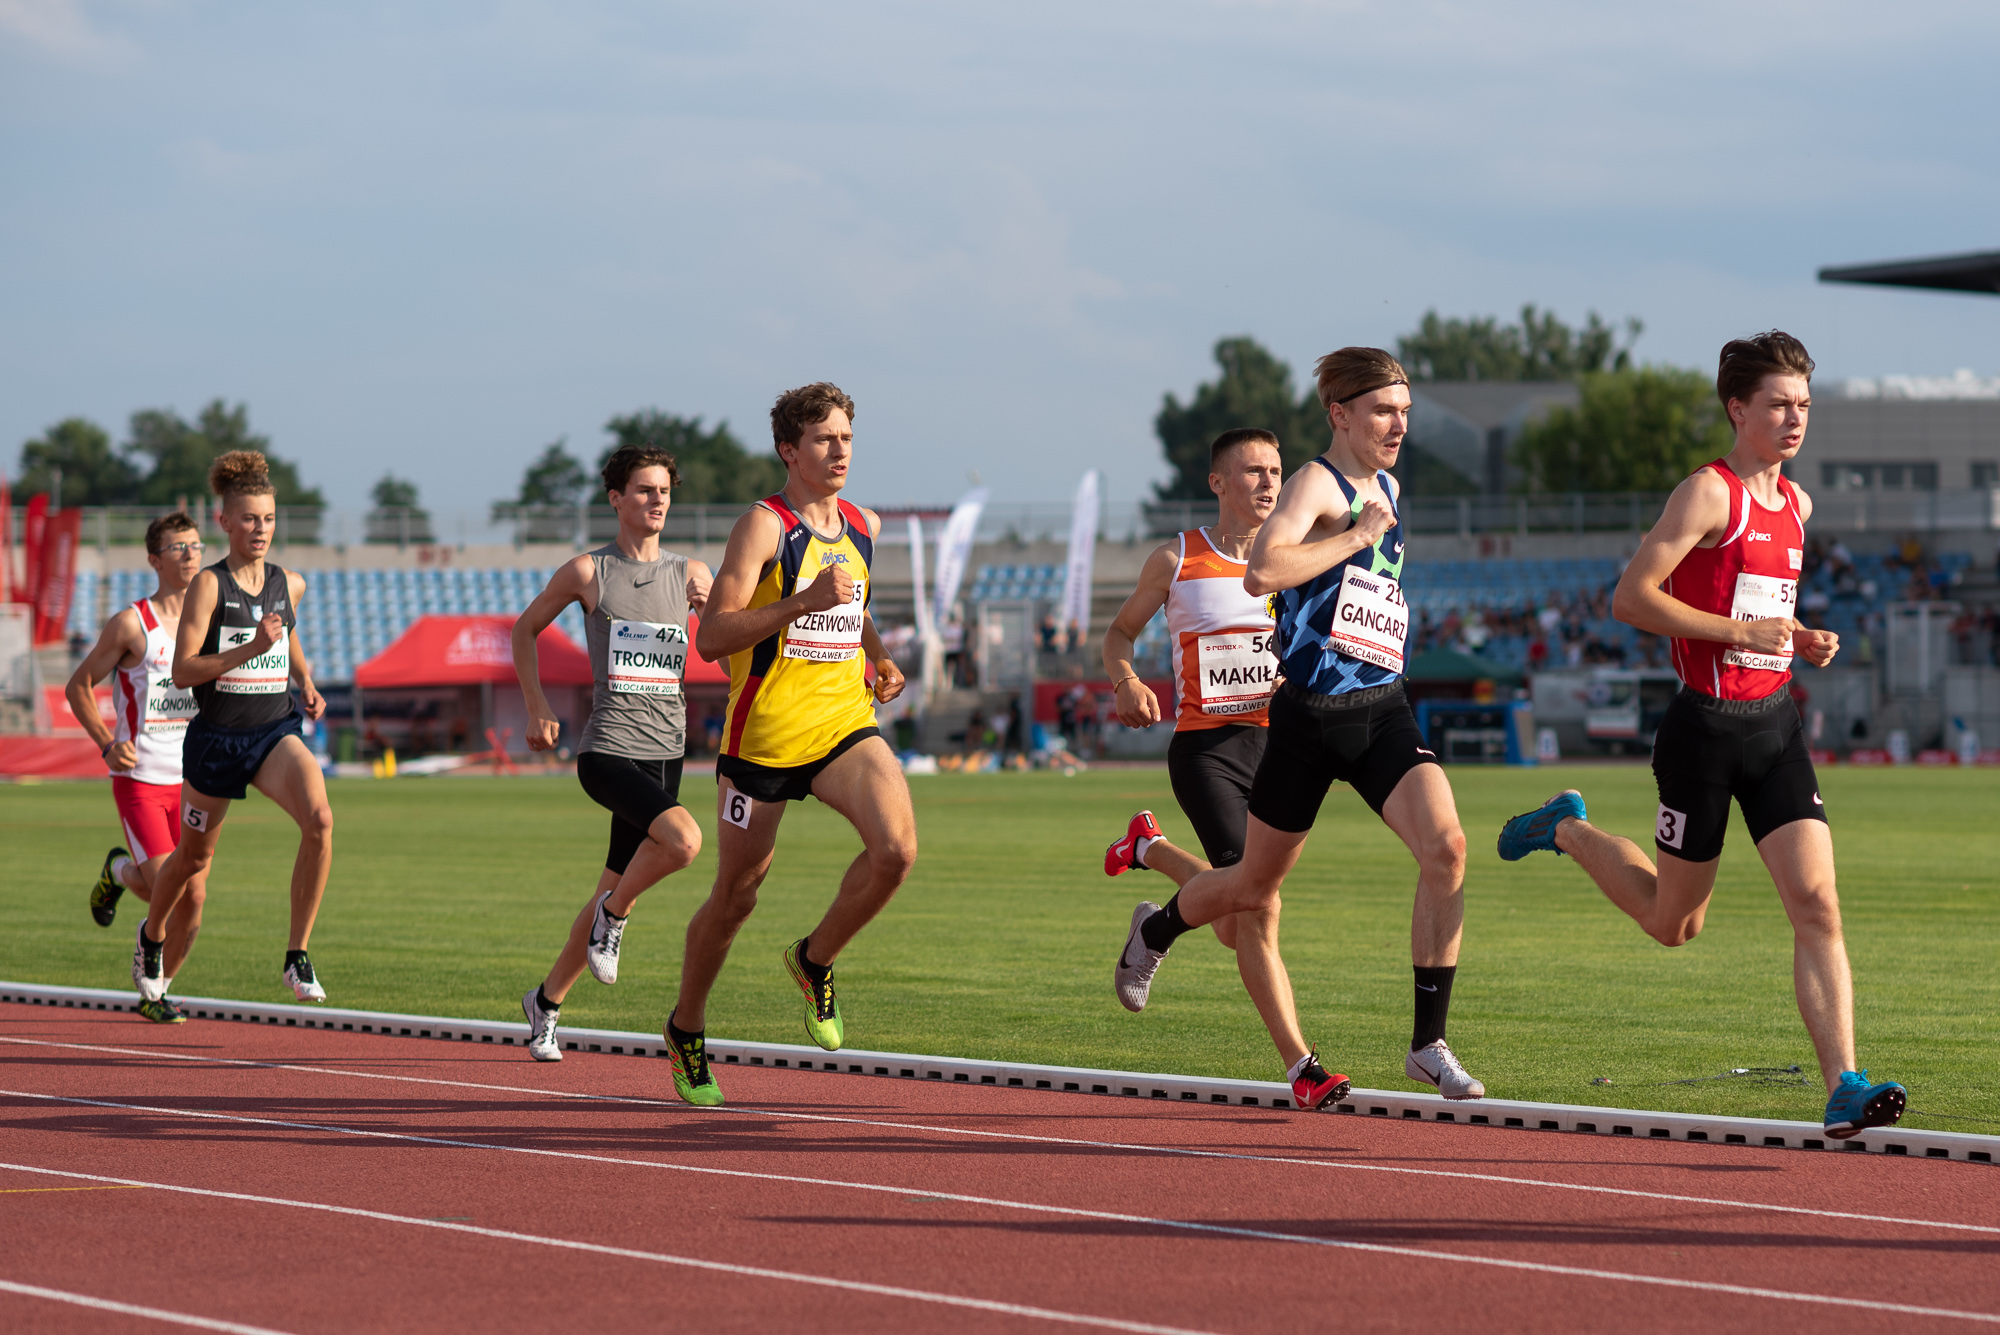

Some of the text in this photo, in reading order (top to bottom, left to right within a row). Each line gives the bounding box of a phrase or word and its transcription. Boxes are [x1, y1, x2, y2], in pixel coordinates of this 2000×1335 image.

[794, 613, 862, 633] CZERWONKA
[1341, 602, 1405, 642] GANCARZ
[228, 632, 251, 645] 4F
[655, 627, 686, 644] 471
[612, 649, 683, 670] TROJNAR
[789, 647, 843, 660] WŁOCŁAWEK
[1333, 640, 1387, 666] WŁOCŁAWEK
[220, 683, 269, 692] WŁOCŁAWEK
[611, 682, 661, 693] WŁOCŁAWEK
[149, 698, 199, 711] KLONOWS
[1208, 700, 1267, 714] WŁOCŁAWEK
[1721, 700, 1761, 714] NIKE
[187, 808, 203, 827] 5
[731, 795, 746, 823] 6
[1660, 811, 1676, 842] 3
